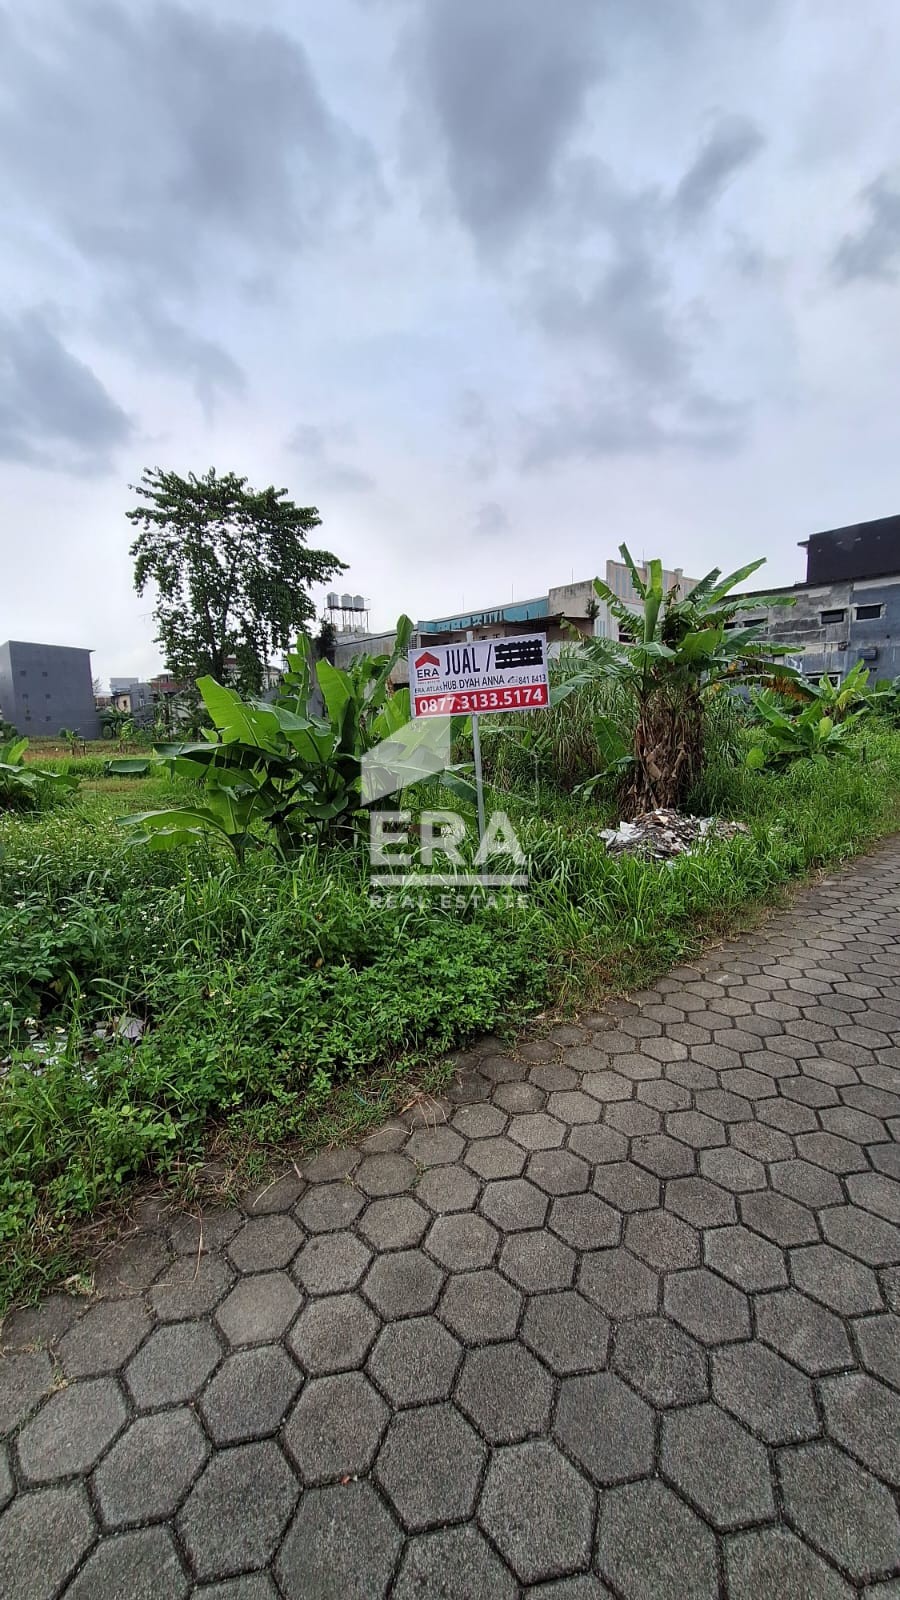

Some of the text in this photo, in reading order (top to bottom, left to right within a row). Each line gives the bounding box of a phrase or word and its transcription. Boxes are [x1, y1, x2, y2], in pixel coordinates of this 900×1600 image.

[445, 647, 480, 676] JUAL
[417, 668, 440, 678] ERA
[459, 678, 481, 689] DYAH
[482, 675, 504, 687] ANNA
[419, 688, 543, 713] 0877.3133.5174
